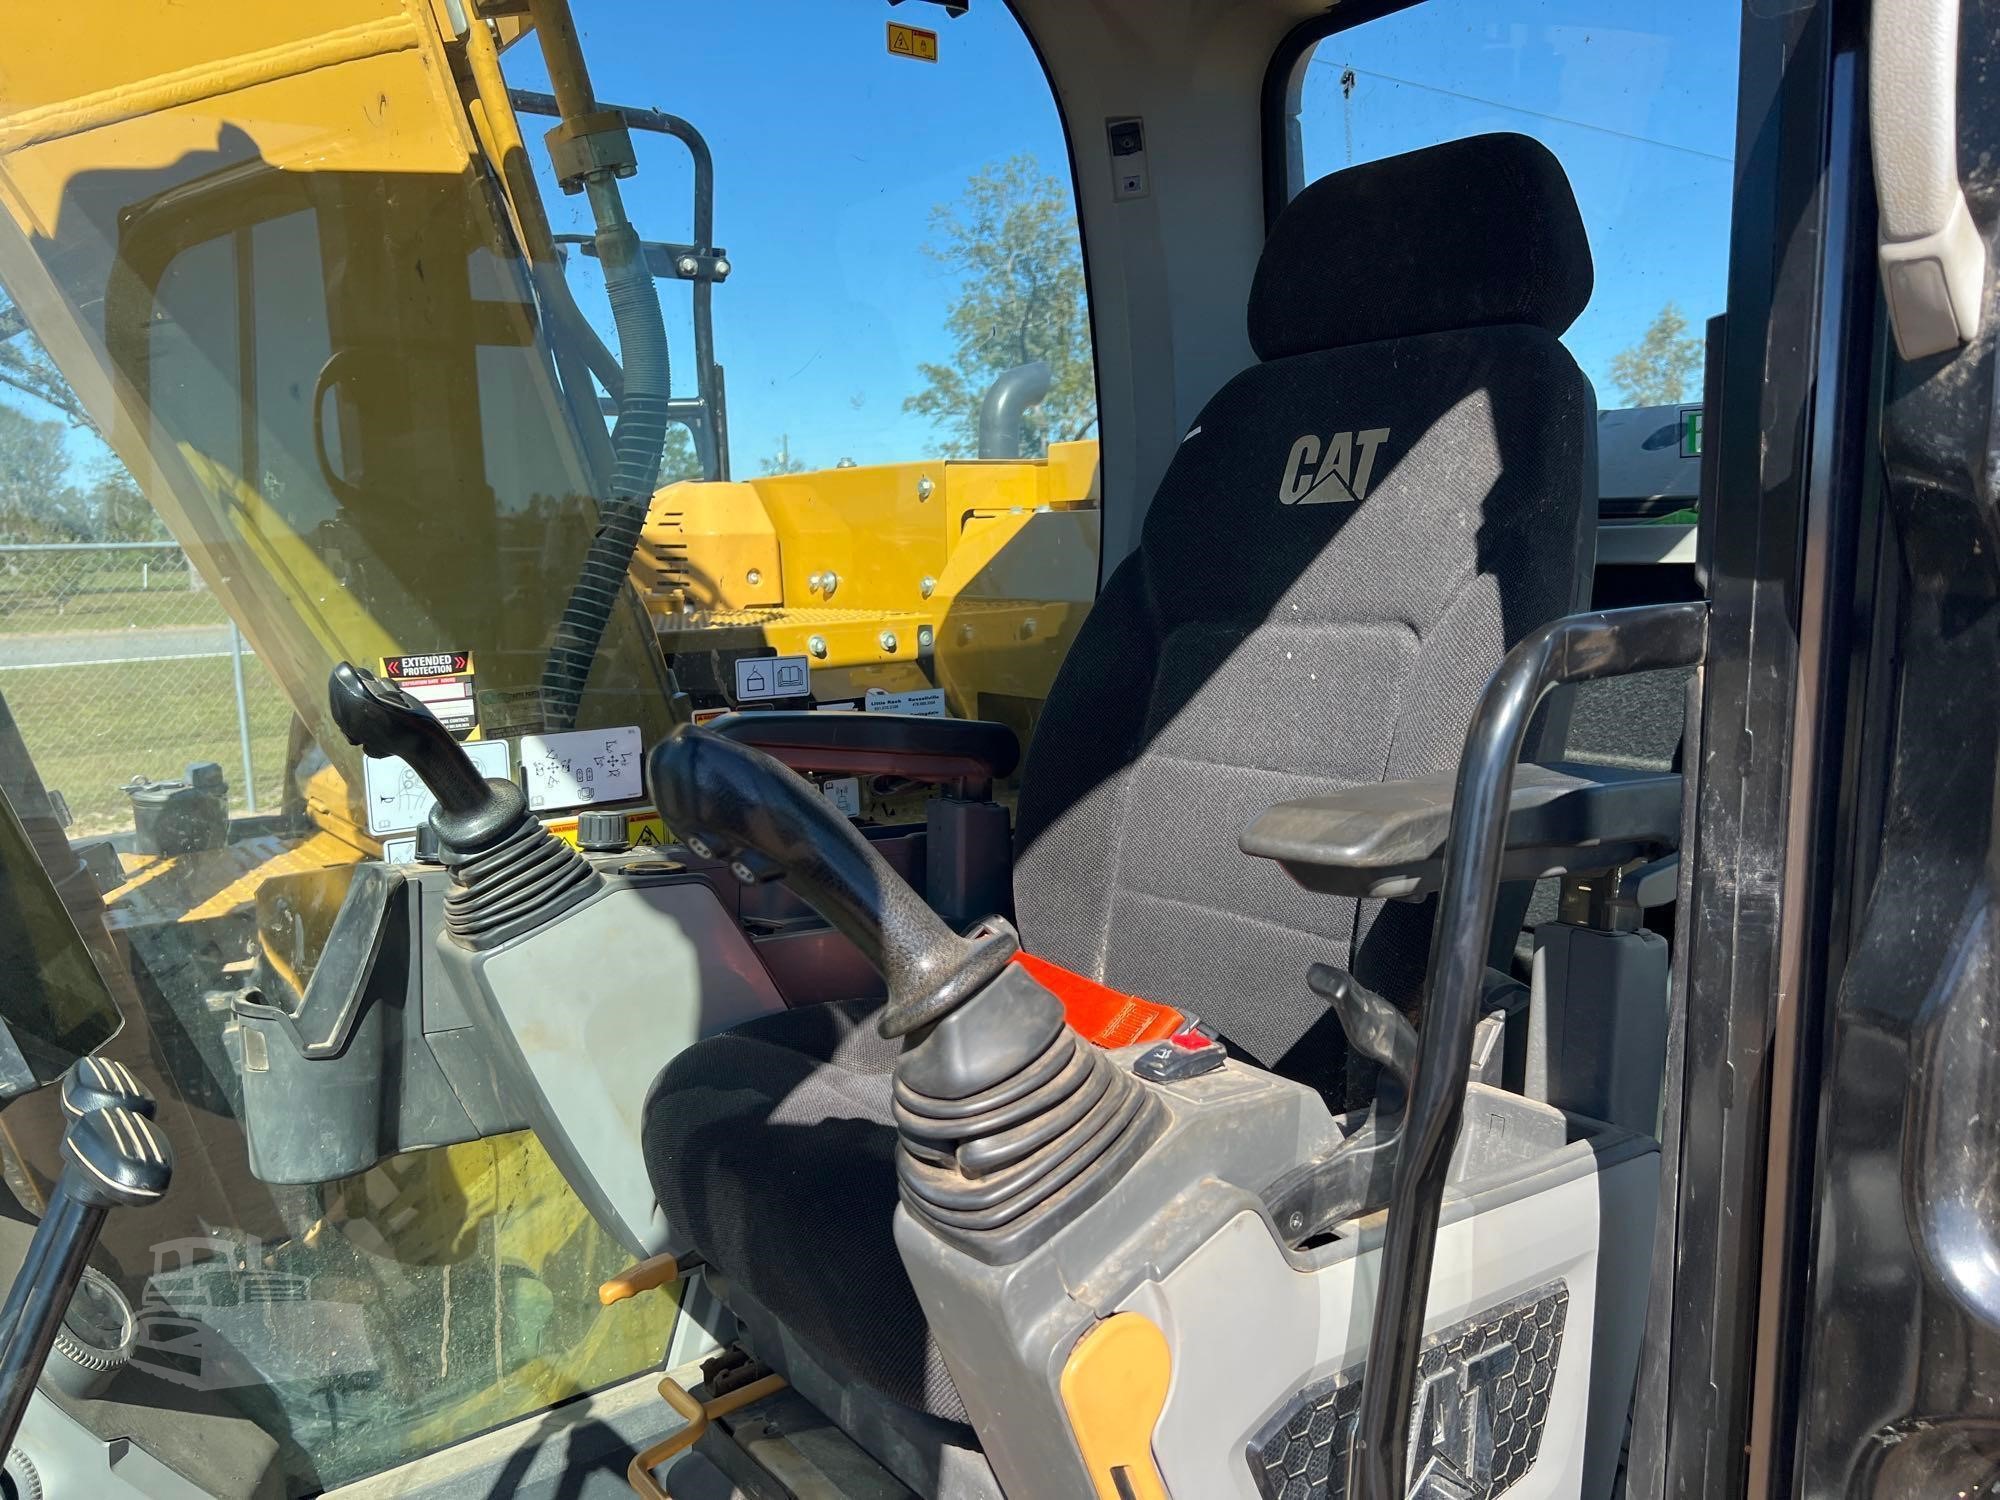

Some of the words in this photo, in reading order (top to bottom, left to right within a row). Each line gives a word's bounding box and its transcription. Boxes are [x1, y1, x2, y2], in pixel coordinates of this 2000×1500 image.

[1280, 428, 1390, 505] CAT
[401, 655, 452, 667] EXTENDED
[402, 665, 452, 676] PROTECTION
